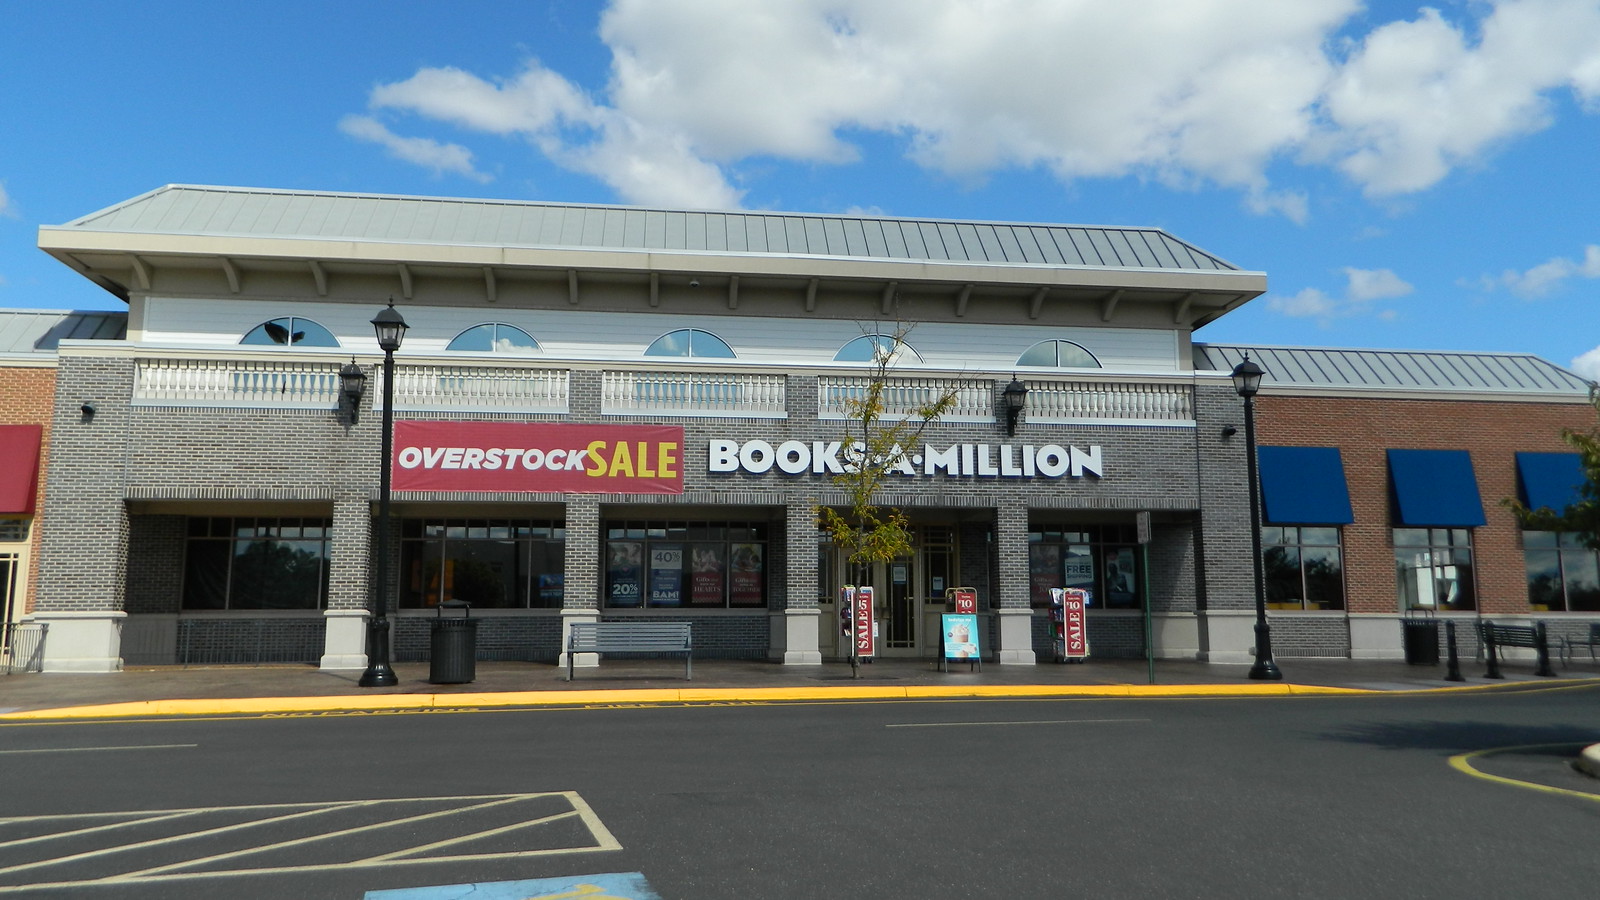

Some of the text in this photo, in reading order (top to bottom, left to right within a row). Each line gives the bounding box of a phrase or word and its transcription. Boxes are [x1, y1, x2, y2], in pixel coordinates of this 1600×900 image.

[399, 440, 677, 478] OVERSTOCK SALE
[655, 551, 681, 562] 40%
[1066, 565, 1092, 573] FREE
[613, 583, 639, 595] 20%
[858, 610, 869, 649] SALE
[1070, 612, 1082, 650] SALE
